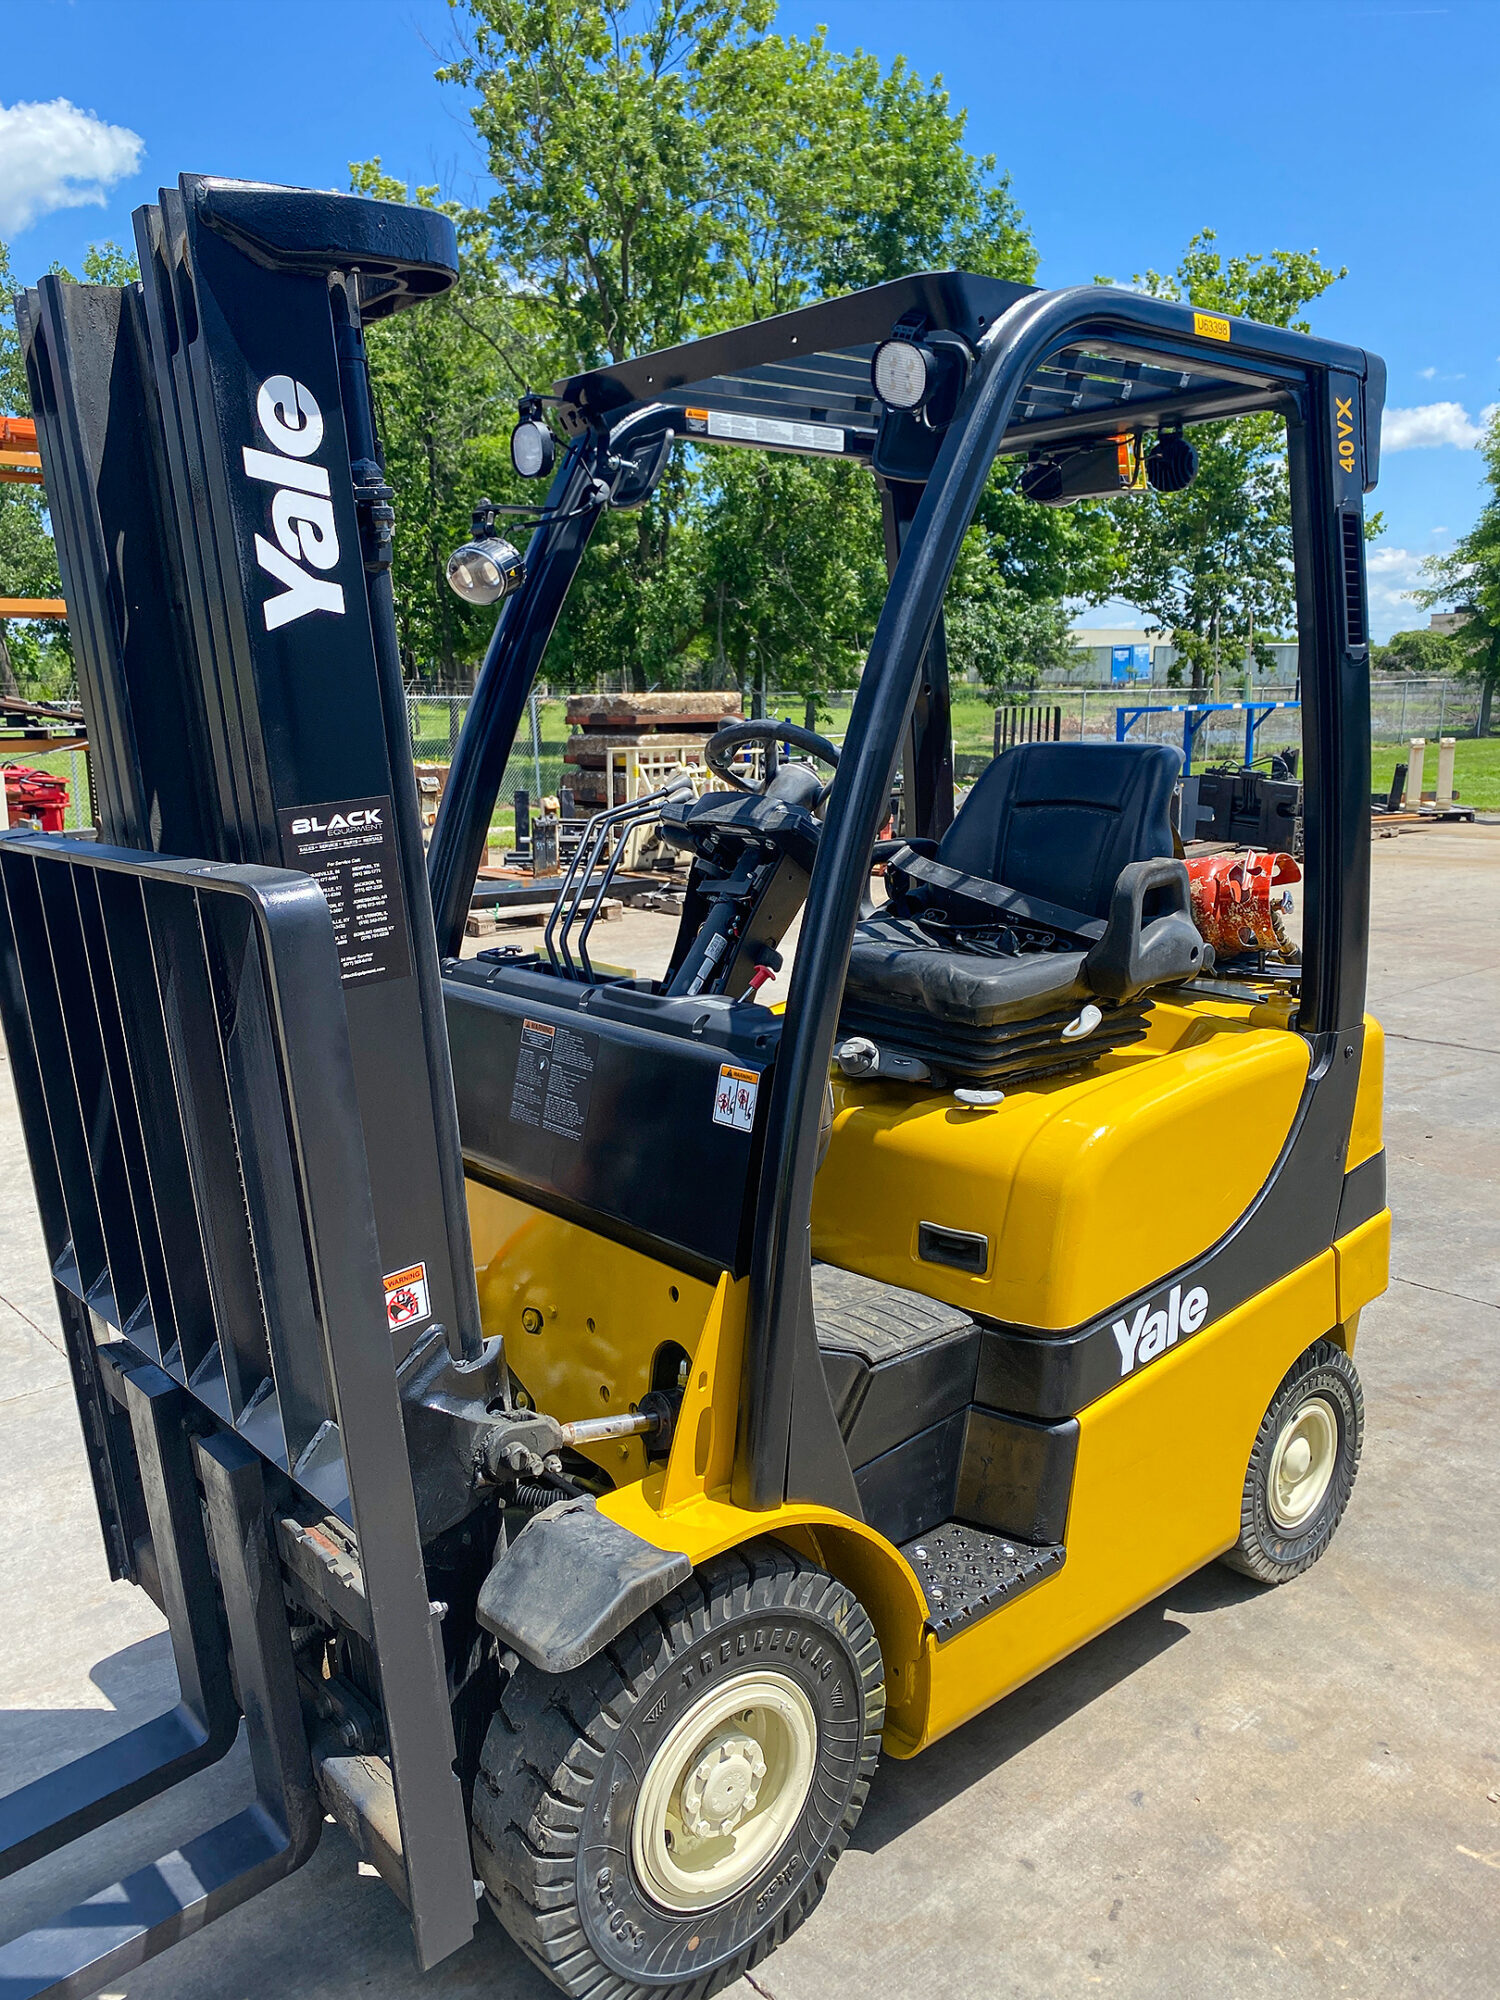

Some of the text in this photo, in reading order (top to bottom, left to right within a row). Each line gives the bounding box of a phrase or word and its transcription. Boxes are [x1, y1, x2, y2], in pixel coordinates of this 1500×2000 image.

[1197, 317, 1228, 336] U63398
[1335, 397, 1356, 474] 40VX
[243, 375, 345, 631] Yale
[292, 809, 384, 835] BLACK
[327, 822, 384, 837] EQUIPMENT
[387, 1270, 421, 1288] WARNING
[1111, 1284, 1209, 1377] Yale
[679, 1628, 834, 1690] TRELLEBORG
